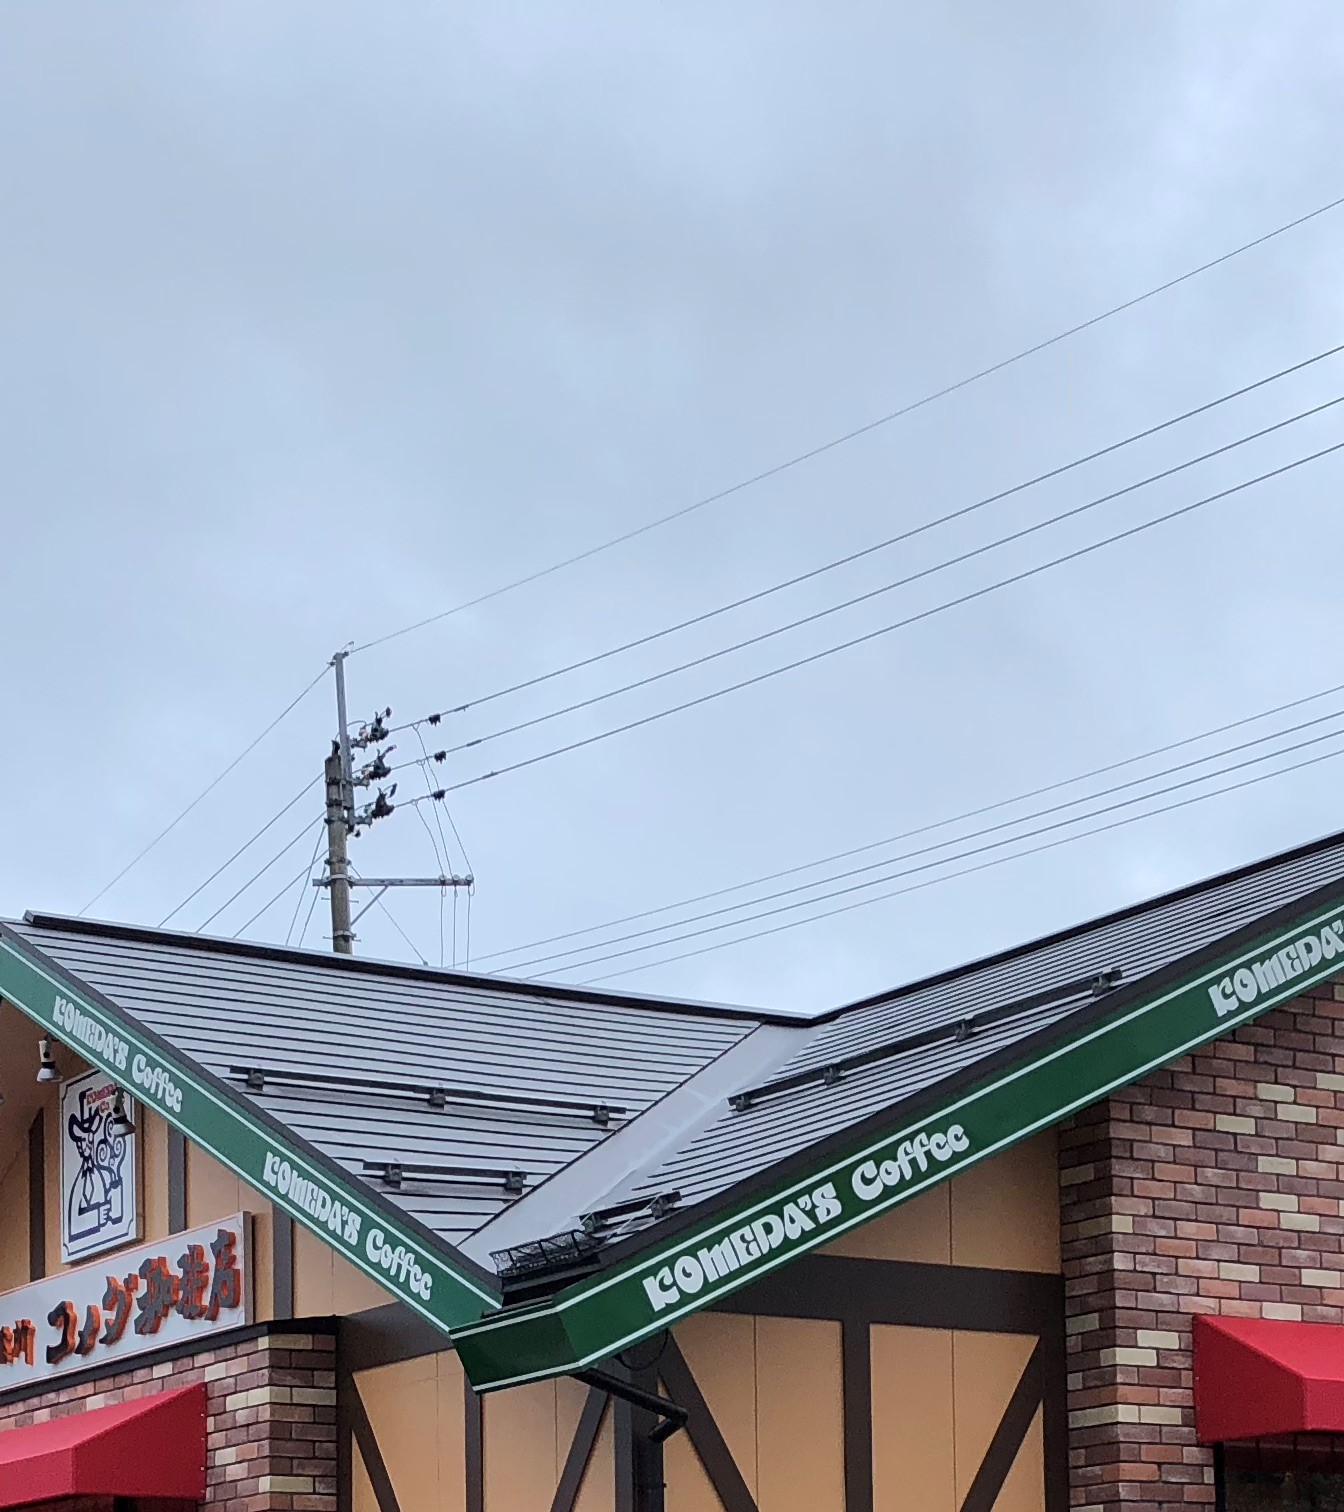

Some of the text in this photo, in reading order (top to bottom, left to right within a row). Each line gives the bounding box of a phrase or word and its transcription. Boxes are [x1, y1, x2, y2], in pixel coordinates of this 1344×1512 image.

[52, 995, 183, 1113] KOMEDA'S Coffee
[262, 1151, 433, 1301] KOMEDA'S Coffee
[642, 1124, 970, 1312] KOMEDA'S Coffee
